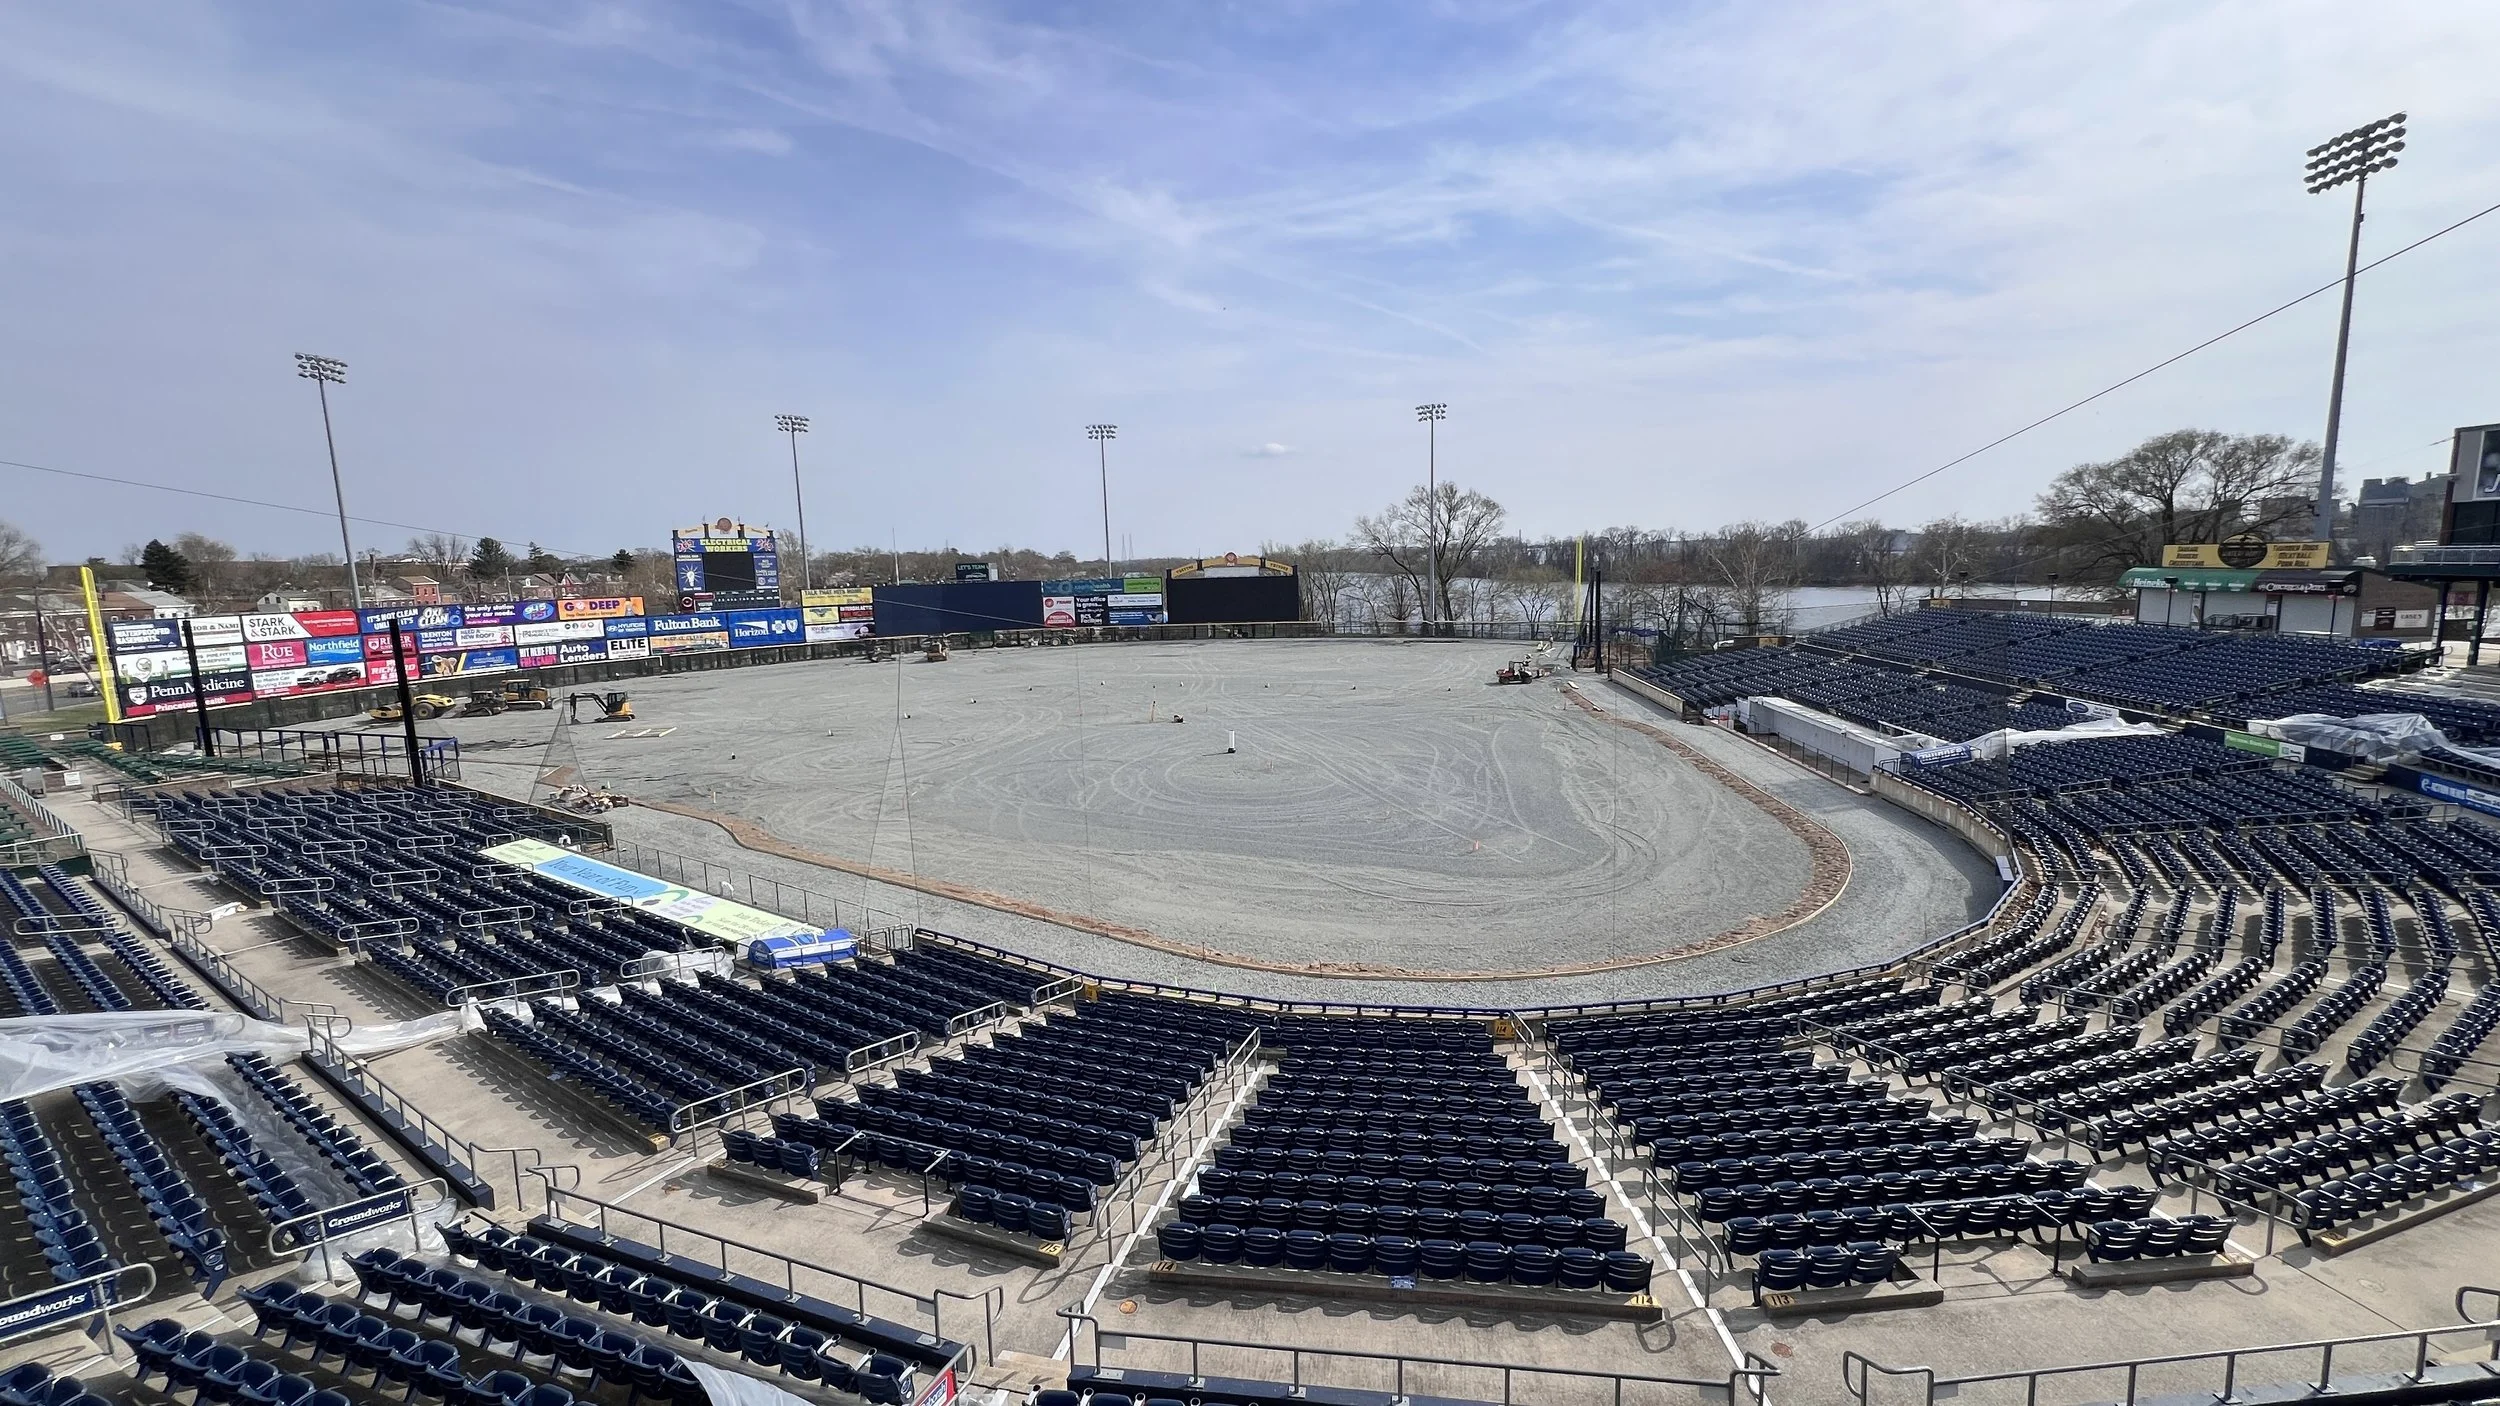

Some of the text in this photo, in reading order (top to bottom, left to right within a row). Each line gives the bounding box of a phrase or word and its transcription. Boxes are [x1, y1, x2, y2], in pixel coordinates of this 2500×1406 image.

[477, 605, 491, 613] only
[589, 599, 621, 611] DEEP
[367, 608, 418, 624] IT'S NOT CLEAN
[424, 607, 443, 618] OXI
[465, 612, 481, 620] your
[249, 617, 285, 628] STARK
[401, 617, 414, 626] IT'S
[419, 615, 449, 627] CLEAN
[654, 616, 721, 631] Fulton Bank
[735, 628, 769, 638] Horizon
[379, 635, 412, 645] RIER
[611, 639, 646, 651] ELITE
[309, 640, 360, 652] Northfield
[561, 644, 589, 654] Auto
[519, 648, 530, 658] HIT
[560, 652, 606, 663] Lenders
[150, 684, 185, 698] Penn
[184, 678, 245, 695] Medicine
[155, 697, 226, 712] Princeton ealth
[328, 1201, 402, 1228] Groundworks
[1041, 1243, 1059, 1253] 115
[1156, 1262, 1174, 1271] 114
[1771, 1295, 1789, 1305] 113
